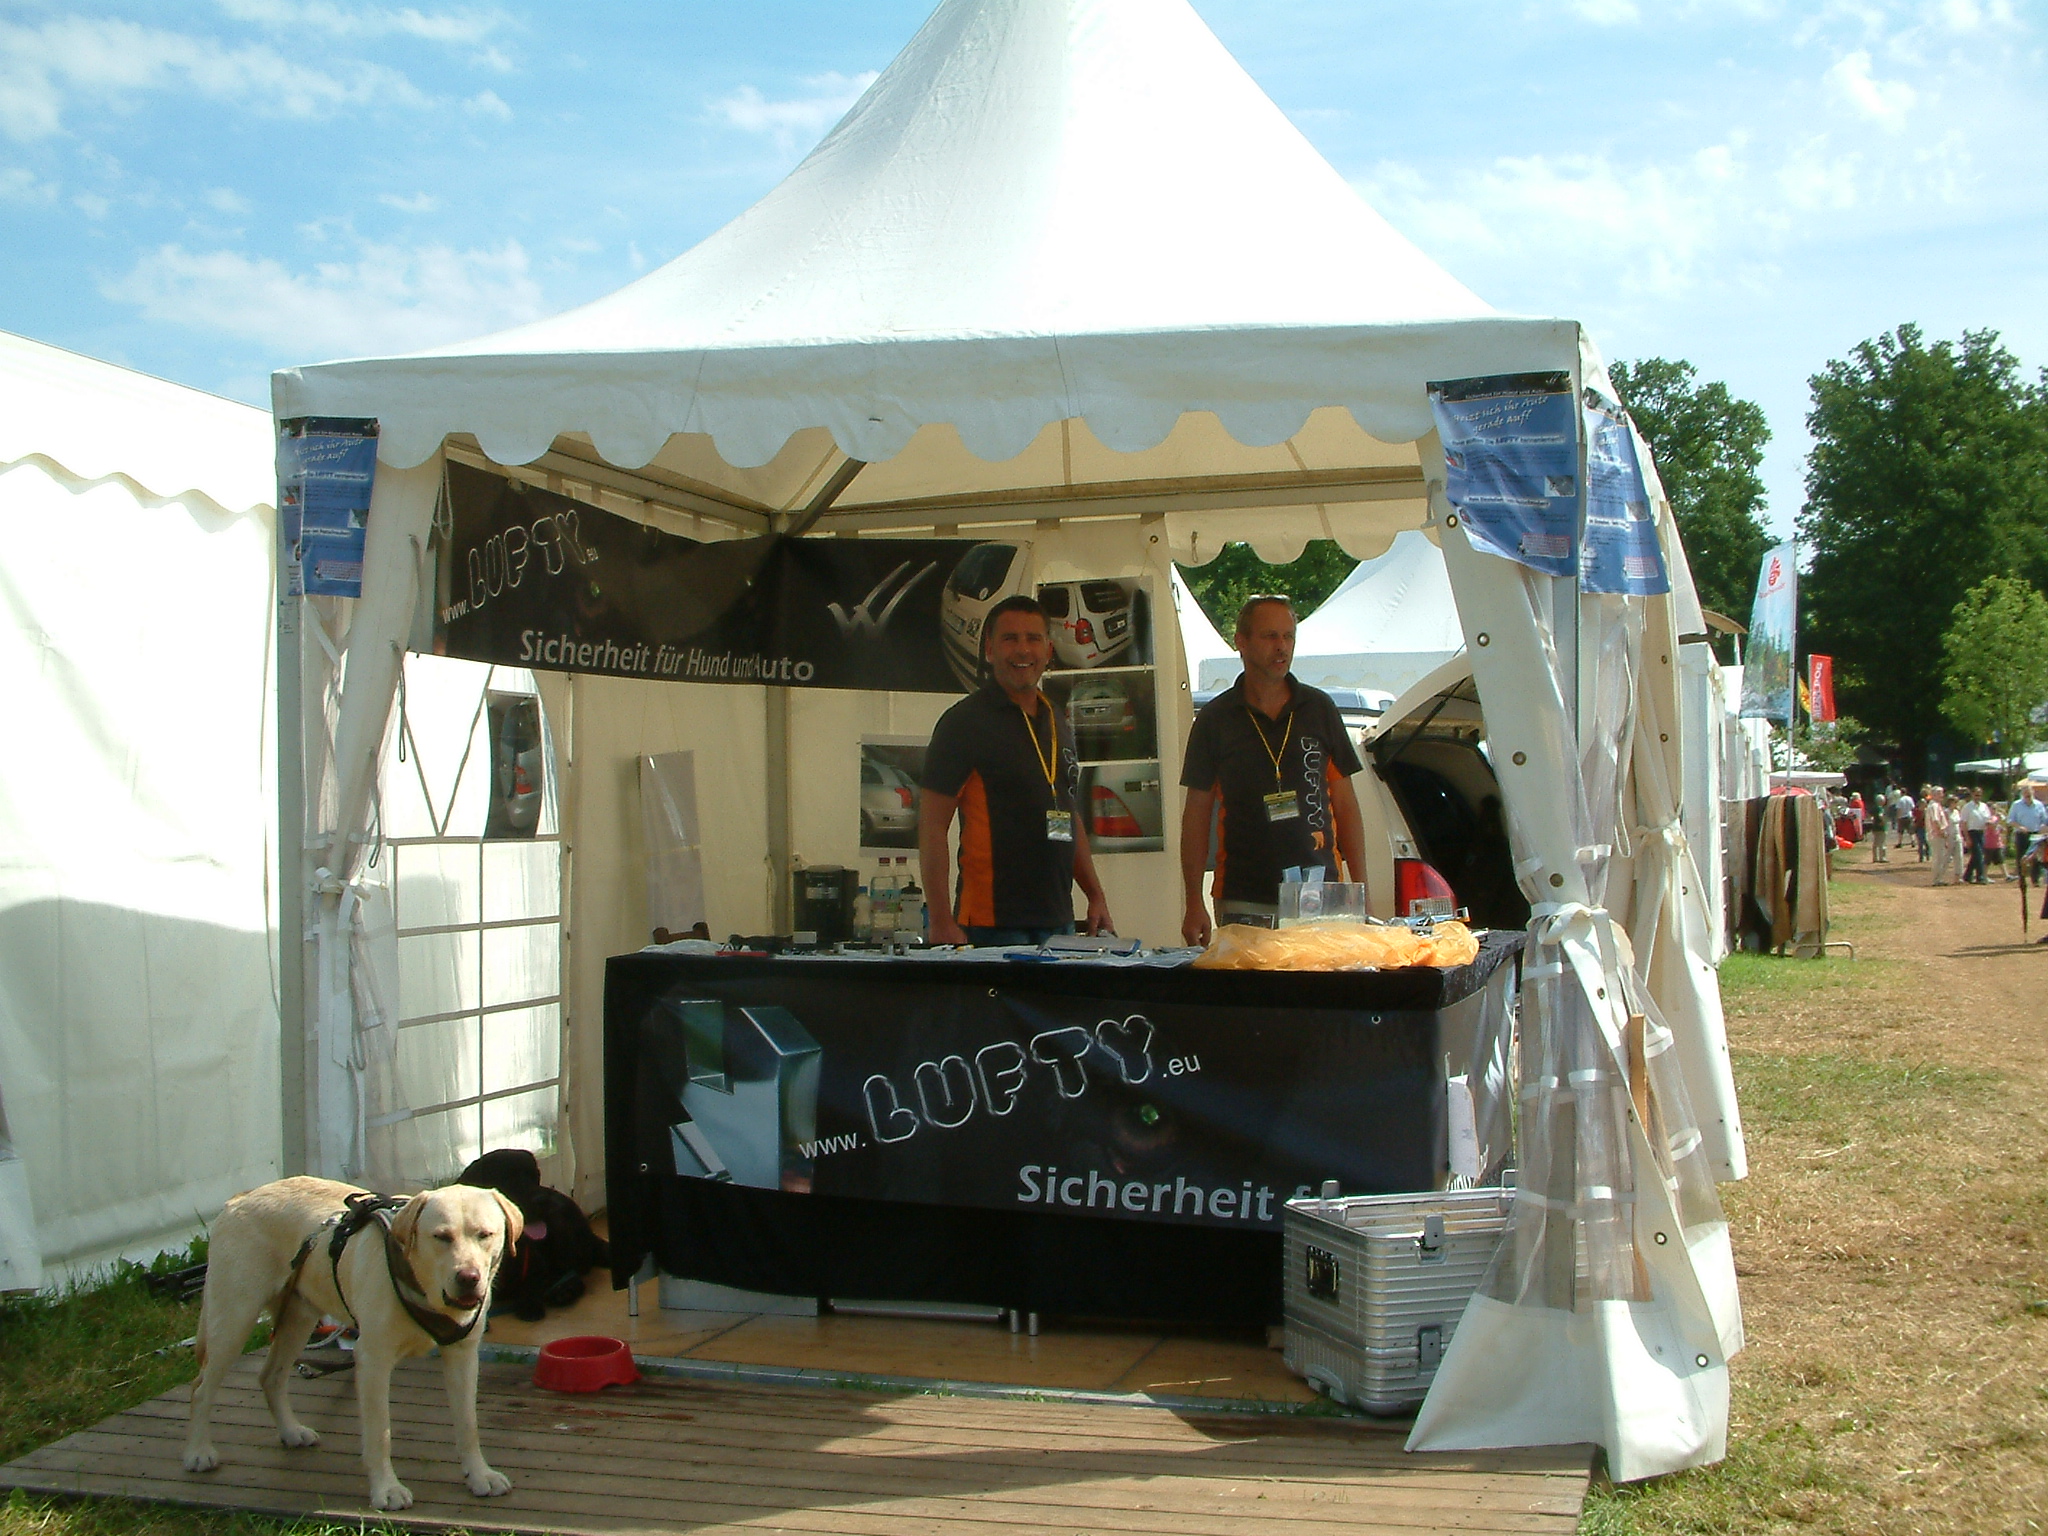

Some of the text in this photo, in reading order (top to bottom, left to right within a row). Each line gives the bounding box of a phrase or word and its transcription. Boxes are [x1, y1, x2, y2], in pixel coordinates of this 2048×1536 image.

[520, 629, 650, 672] Sicherheit
[653, 645, 684, 674] für
[686, 648, 731, 677] Hund
[753, 652, 815, 681] Auto
[1300, 736, 1325, 829] LUFTY
[1017, 1164, 1275, 1222] Sicherheit
